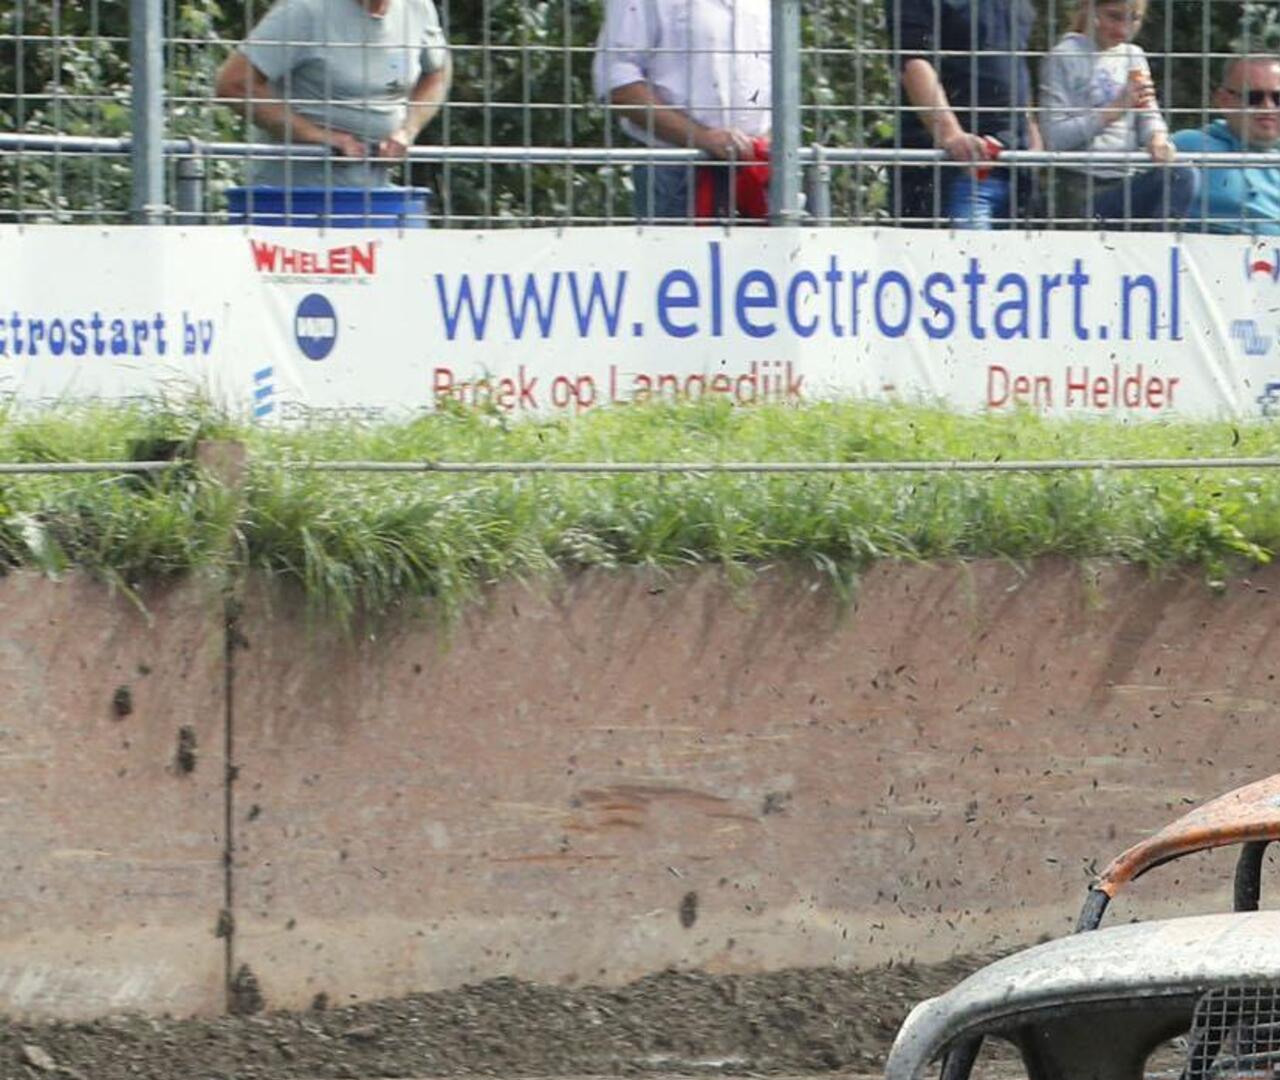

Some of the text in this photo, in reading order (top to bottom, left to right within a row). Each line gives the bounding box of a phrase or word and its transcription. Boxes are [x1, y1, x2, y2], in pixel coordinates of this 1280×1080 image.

[250, 239, 377, 275] WHELEN
[434, 241, 1183, 341] www.electrostart.nl
[182, 311, 213, 355] bv
[551, 374, 597, 413] op
[987, 366, 1053, 409] Den
[1067, 365, 1180, 410] Helder
